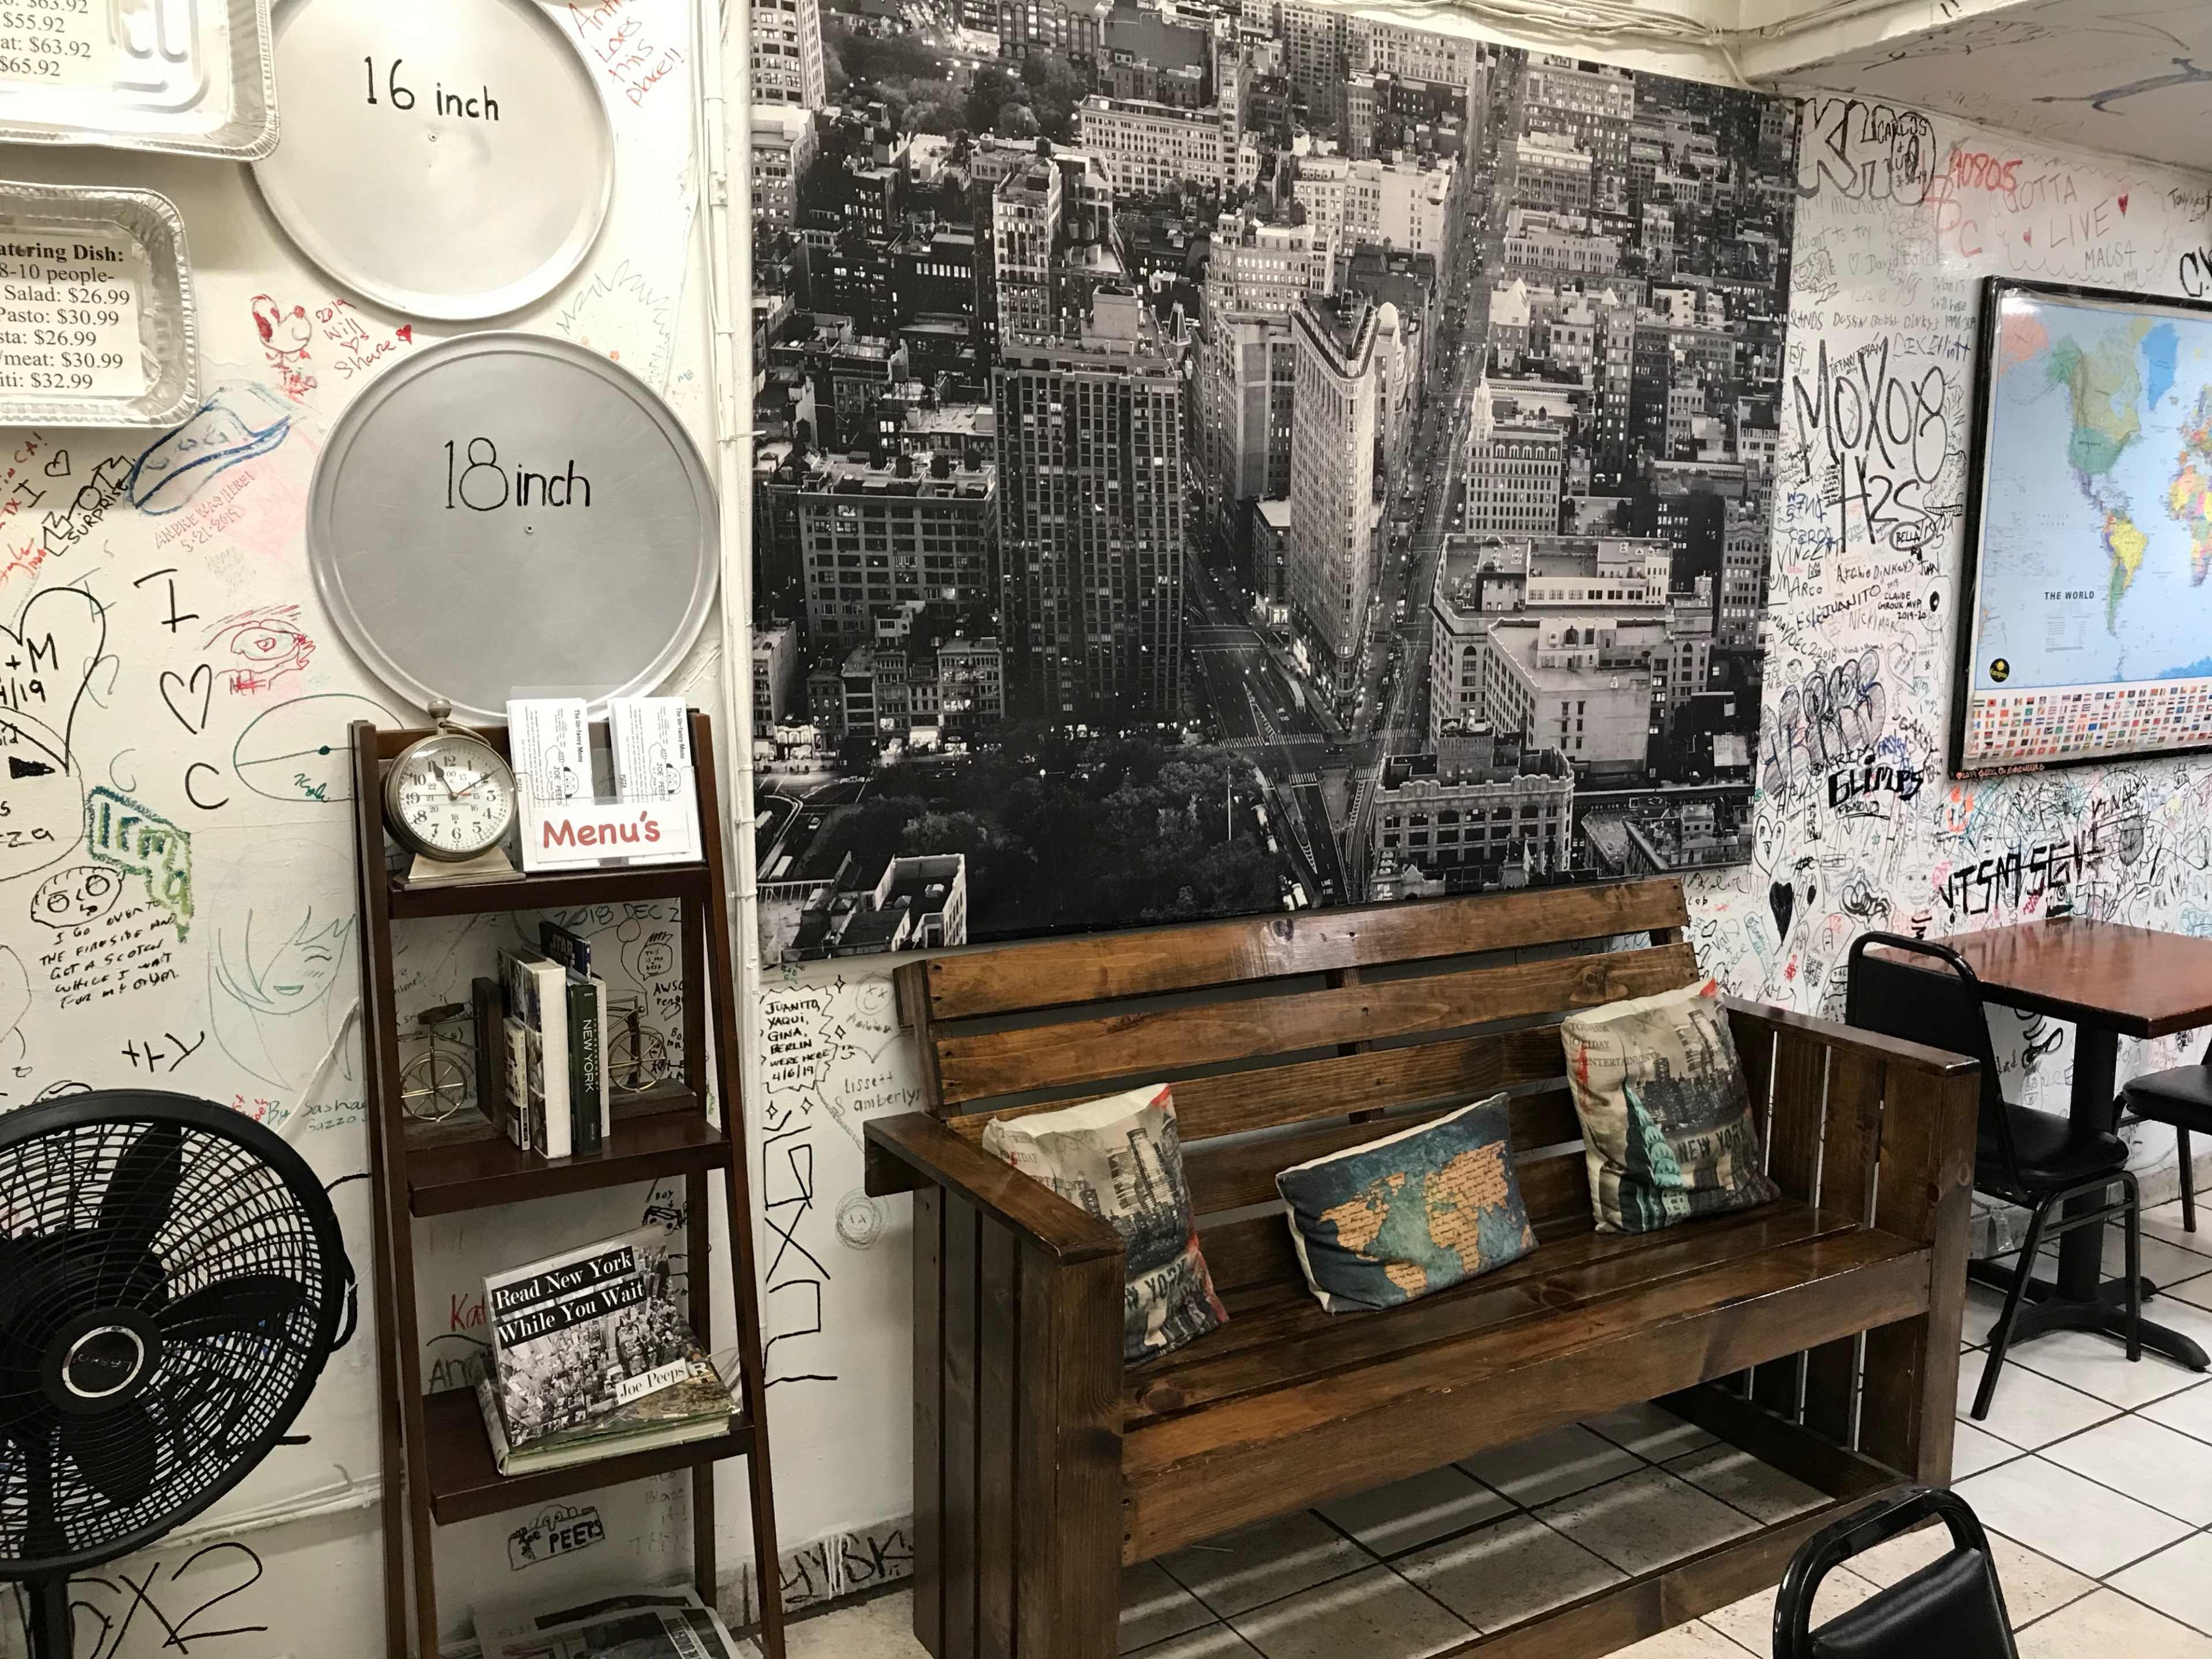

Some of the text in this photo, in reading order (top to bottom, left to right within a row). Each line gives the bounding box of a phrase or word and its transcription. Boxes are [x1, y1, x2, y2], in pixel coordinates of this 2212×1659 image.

[3, 12, 65, 33] $55.92
[29, 36, 91, 58] $63.92
[364, 56, 499, 120] 16 inch
[73, 244, 123, 262] Dish:
[5, 285, 130, 305] Salad: $26.99
[57, 308, 119, 326] $30.99
[34, 329, 96, 346] $26.99
[61, 351, 123, 369] $30.99
[31, 372, 93, 389] $32.99
[445, 437, 590, 511] 18 inch
[2044, 590, 2095, 600] THE WORLD
[444, 756, 457, 767] 12
[467, 760, 472, 771] 1
[656, 762, 664, 777] JOE
[413, 773, 426, 786] 10
[553, 766, 562, 781] JOE
[410, 792, 421, 805] 9
[486, 790, 497, 802] 3
[482, 808, 493, 820] 4
[431, 823, 440, 838] 7
[452, 827, 461, 840] 6
[472, 821, 483, 834] 5
[543, 810, 661, 849] Menu's
[624, 903, 663, 921] DEC
[39, 950, 66, 966] THE
[583, 1019, 596, 1093] NEW YORK
[1677, 1120, 1748, 1165] NEW YORK
[494, 1251, 634, 1311] Read New York
[498, 1279, 645, 1345] While You Wait
[619, 1366, 686, 1399] Joe Peeps
